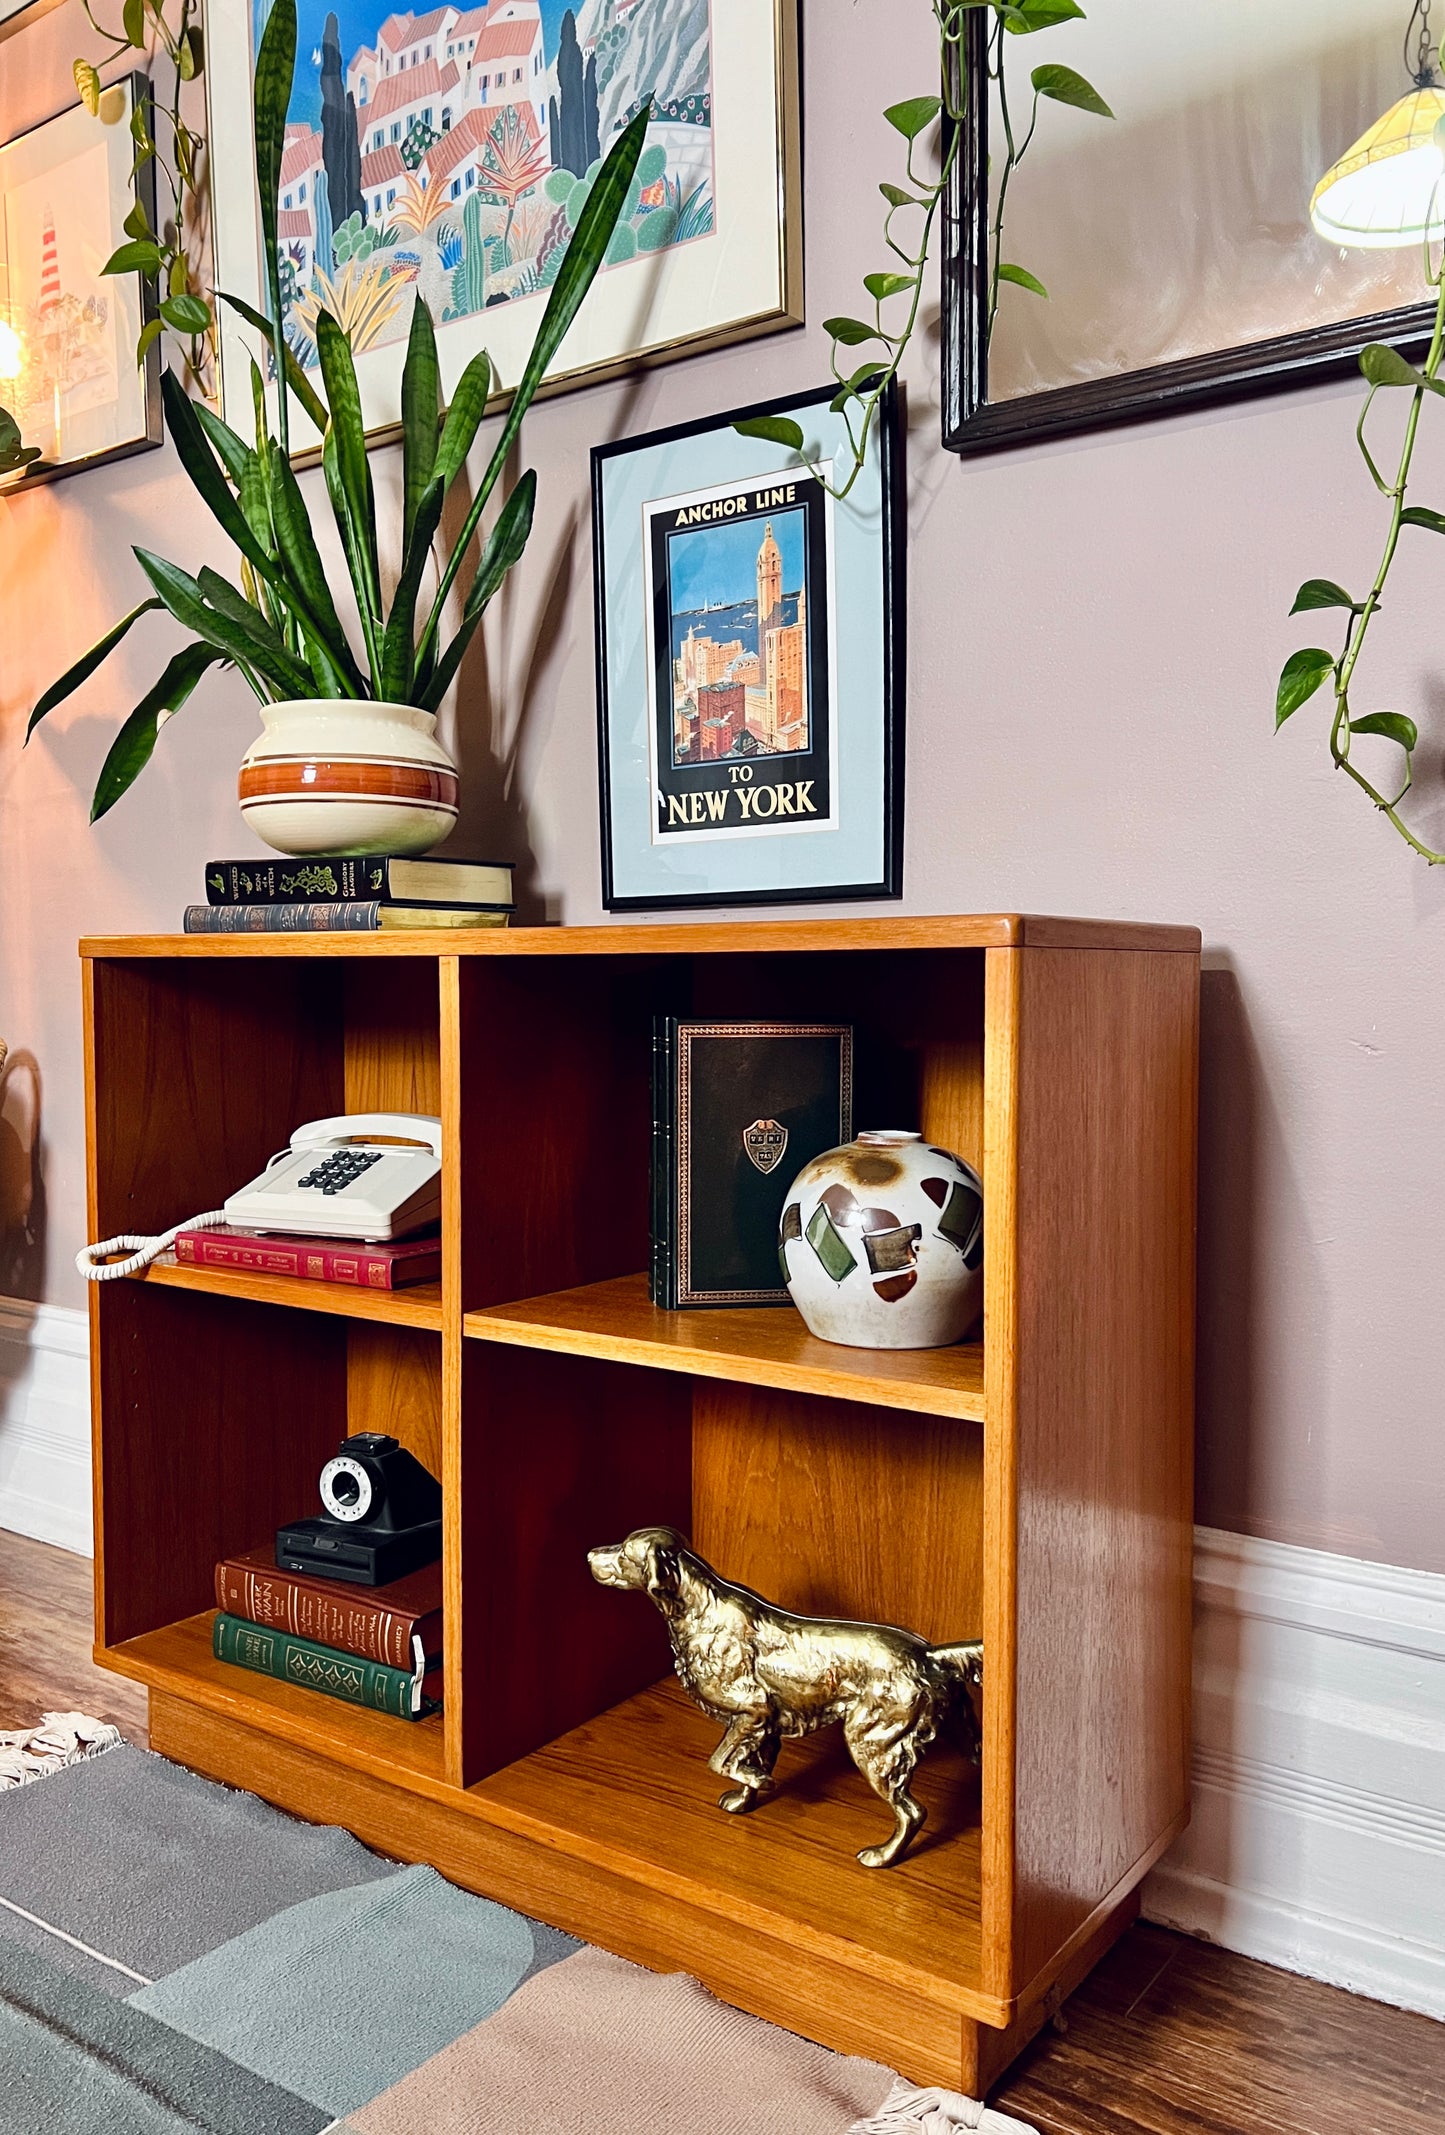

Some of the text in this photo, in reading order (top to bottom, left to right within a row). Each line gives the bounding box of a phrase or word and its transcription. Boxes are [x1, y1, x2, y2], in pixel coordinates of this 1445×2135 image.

[675, 485, 796, 527] ANCHOR LINE
[728, 765, 753, 783] TO
[667, 780, 818, 825] NEW YORK
[231, 866, 239, 900] WICKED
[255, 1584, 264, 1617] MARK
[263, 1582, 274, 1622] TWAIN
